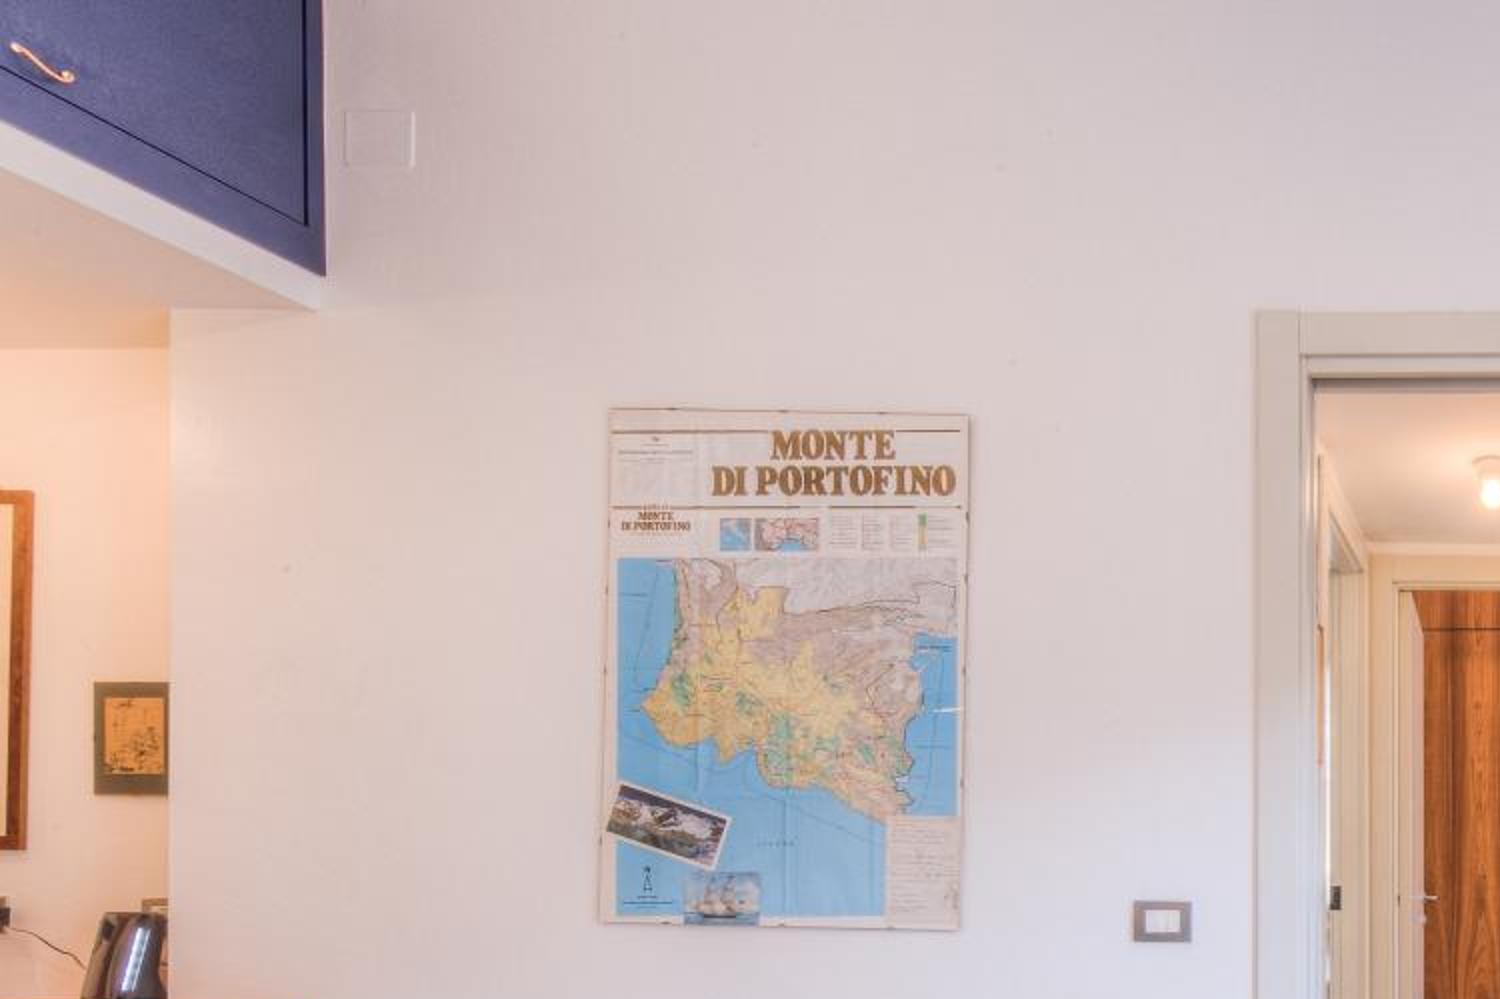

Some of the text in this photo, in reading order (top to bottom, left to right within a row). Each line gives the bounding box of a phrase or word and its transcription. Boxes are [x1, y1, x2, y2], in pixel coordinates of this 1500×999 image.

[770, 430, 896, 461] MONTE
[712, 465, 957, 497] DI PORTOFINO
